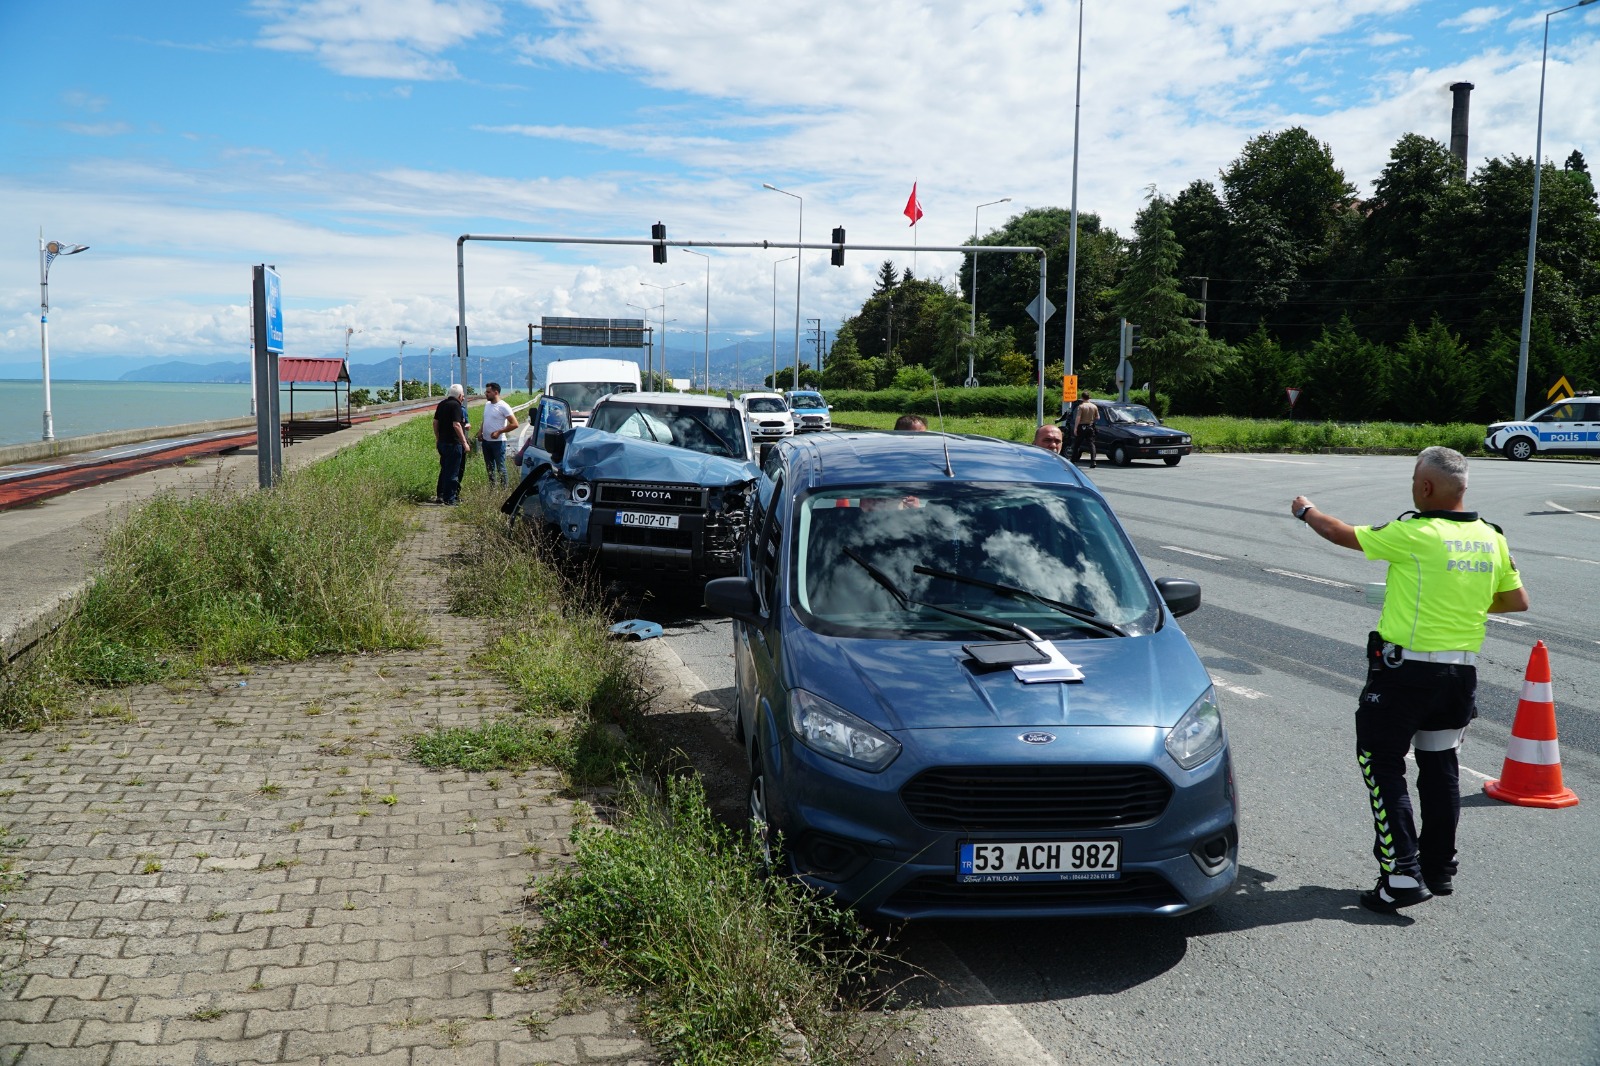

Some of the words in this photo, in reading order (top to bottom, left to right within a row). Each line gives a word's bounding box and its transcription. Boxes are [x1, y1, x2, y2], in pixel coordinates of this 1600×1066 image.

[1550, 432, 1579, 441] POLİS
[631, 490, 671, 499] TOYOTA
[1027, 733, 1048, 742] Ford
[974, 846, 1005, 871] 53
[1016, 845, 1061, 870] ACH
[1071, 844, 1115, 869] 982
